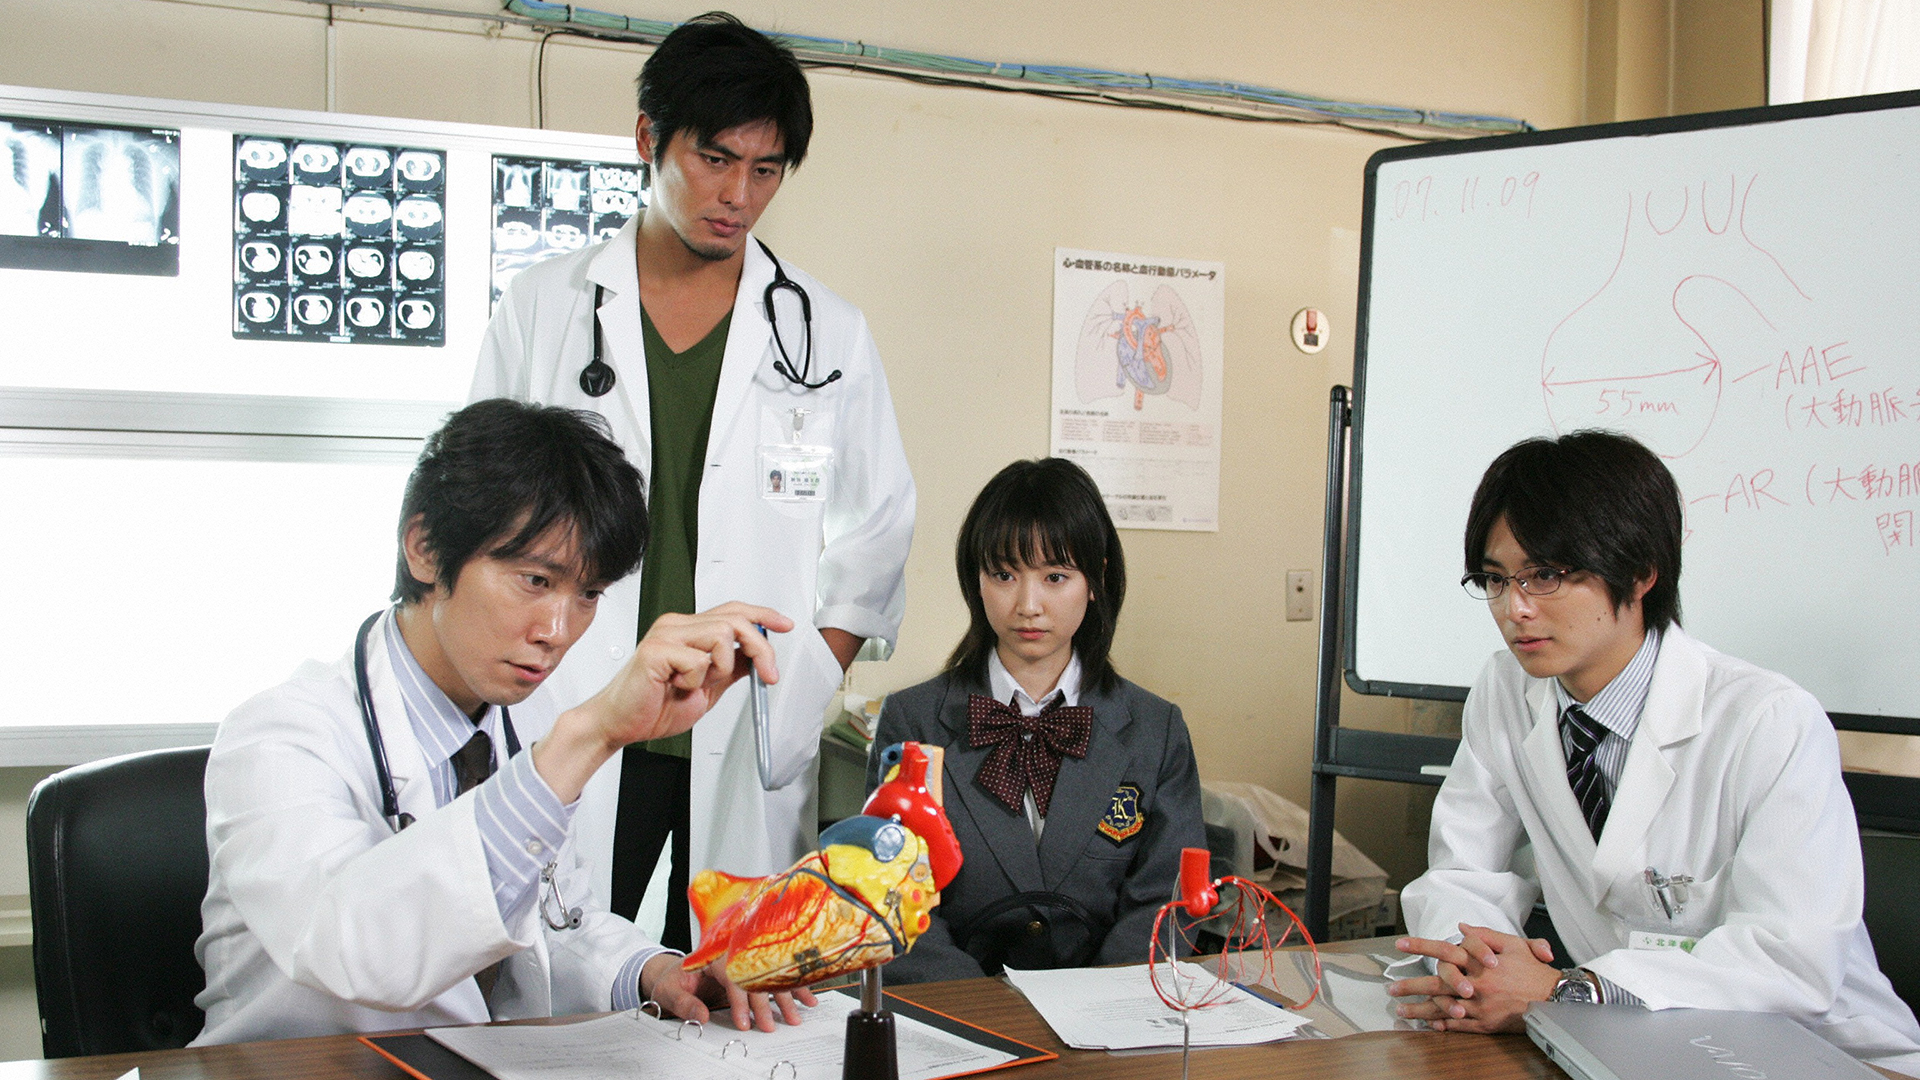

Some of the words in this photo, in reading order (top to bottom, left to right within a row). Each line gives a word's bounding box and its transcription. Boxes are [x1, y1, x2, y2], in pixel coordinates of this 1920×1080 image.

[1776, 341, 1867, 390] AAE
[1595, 389, 1680, 416] 55mm
[1725, 468, 1791, 513] AR
